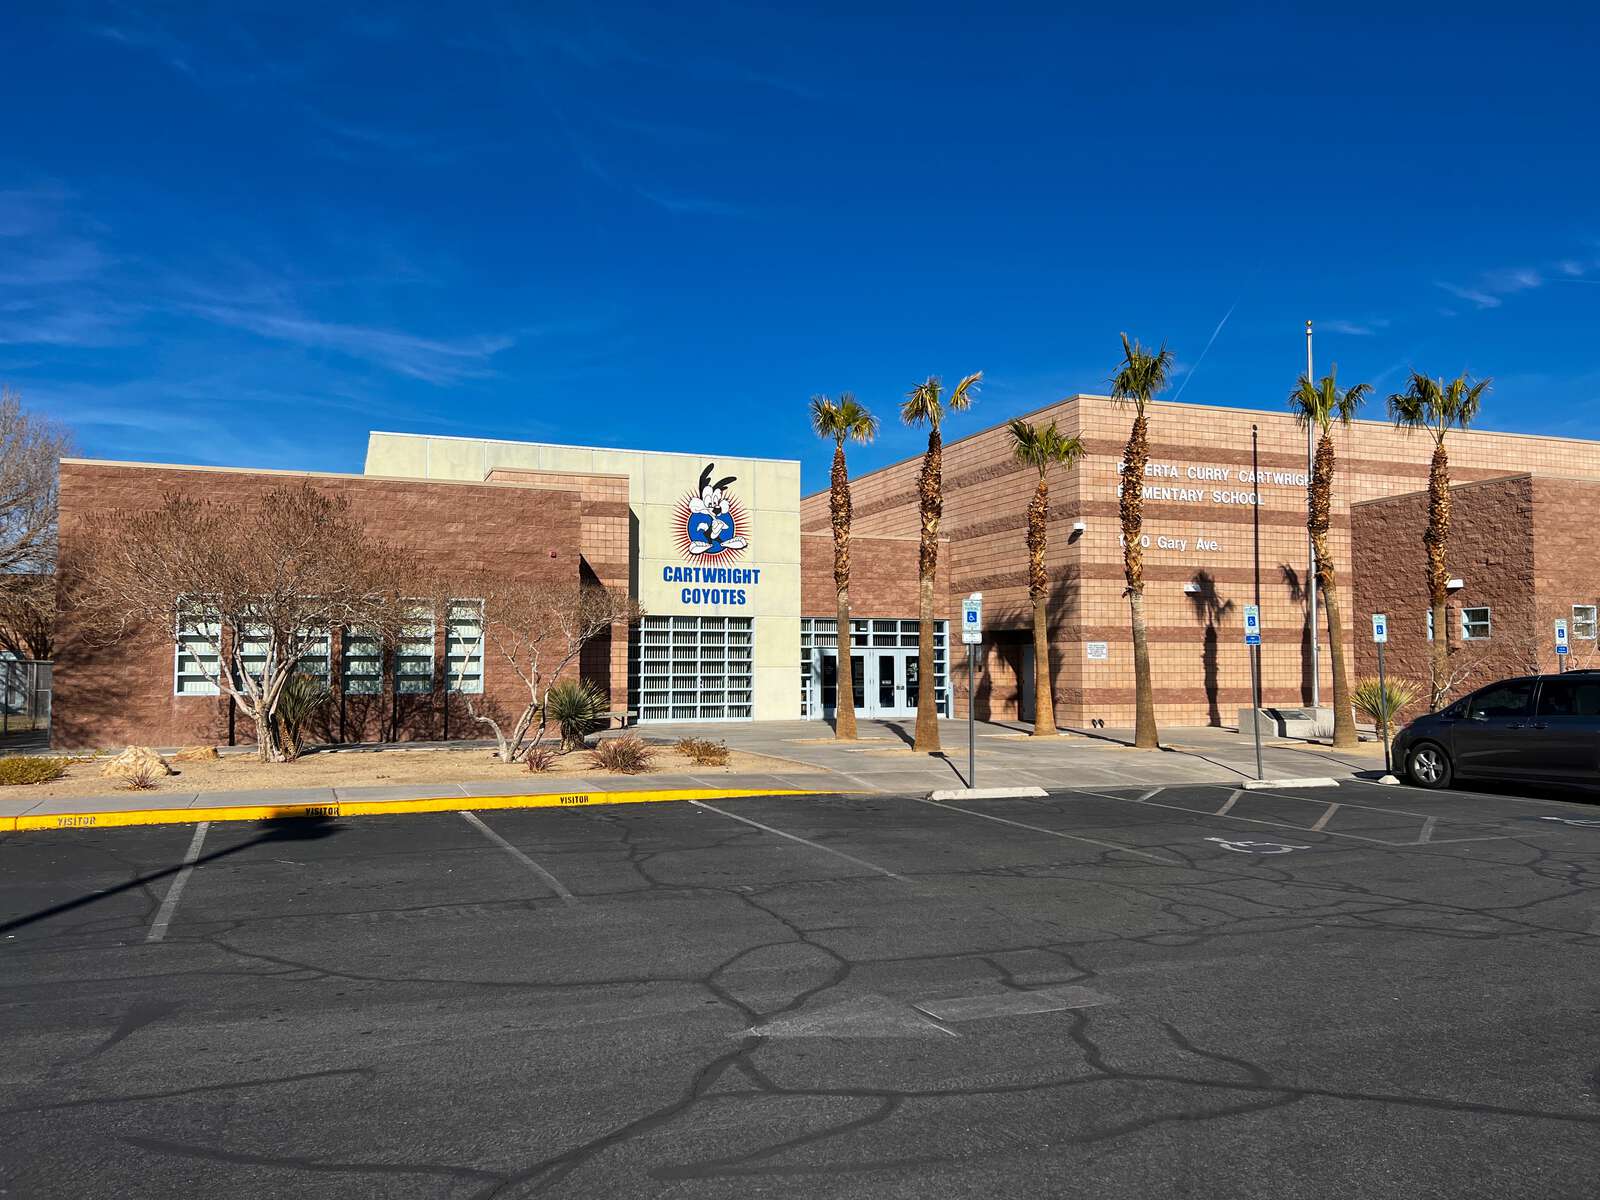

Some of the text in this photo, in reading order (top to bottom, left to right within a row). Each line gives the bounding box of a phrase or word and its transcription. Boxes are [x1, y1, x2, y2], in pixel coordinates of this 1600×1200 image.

[1117, 461, 1178, 479] RERTA
[1187, 467, 1230, 482] CURRY
[1117, 483, 1265, 506] EMENTARY SCHOOL
[1157, 535, 1188, 552] Gary
[1195, 537, 1223, 552] Ave.
[663, 566, 760, 584] CARTWRIGHT
[681, 588, 746, 605] COYOTES
[560, 796, 588, 804] VISITOR
[305, 807, 340, 816] VISITOR
[57, 816, 96, 826] VISITOR
